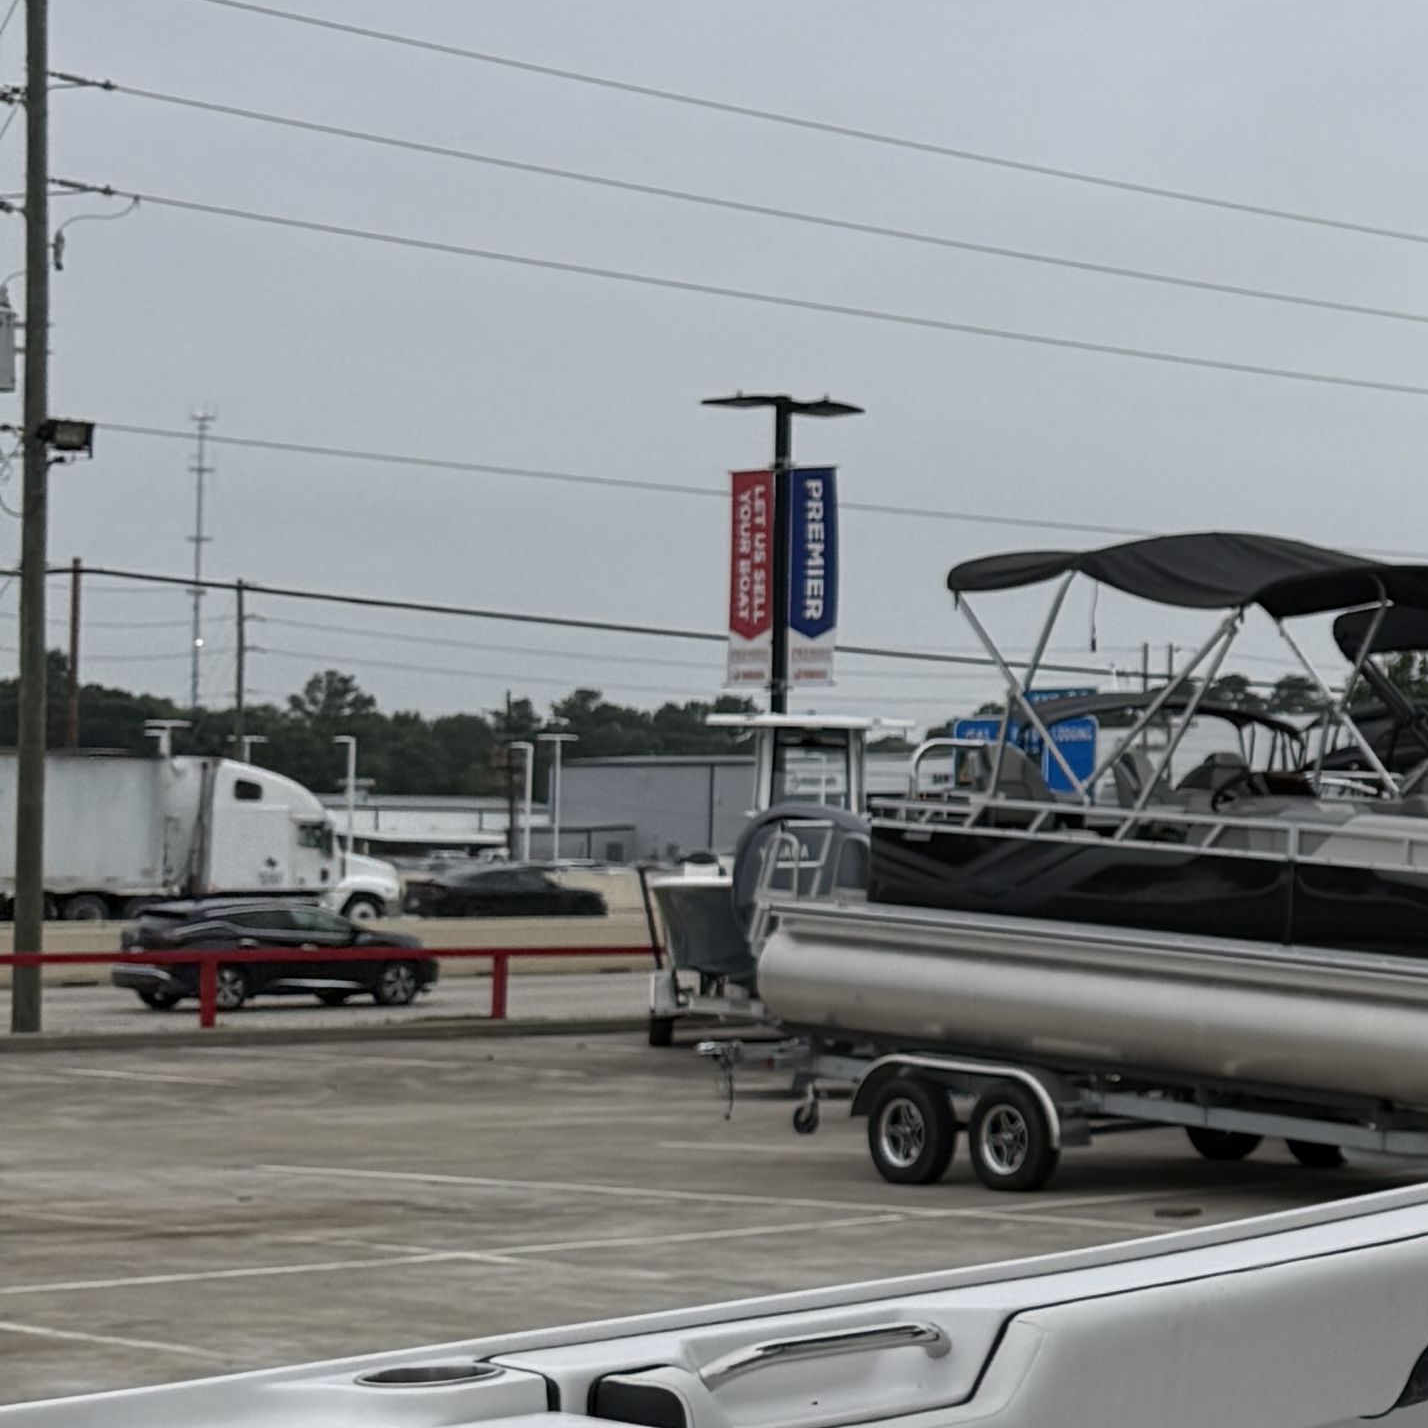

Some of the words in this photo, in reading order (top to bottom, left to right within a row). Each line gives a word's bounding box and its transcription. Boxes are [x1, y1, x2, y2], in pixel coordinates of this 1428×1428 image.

[739, 490, 751, 555] YOUR
[754, 485, 766, 528] LET
[754, 532, 766, 564] US
[804, 478, 825, 621] PREMIER
[737, 559, 751, 621] BOAT
[753, 568, 766, 625] SELL
